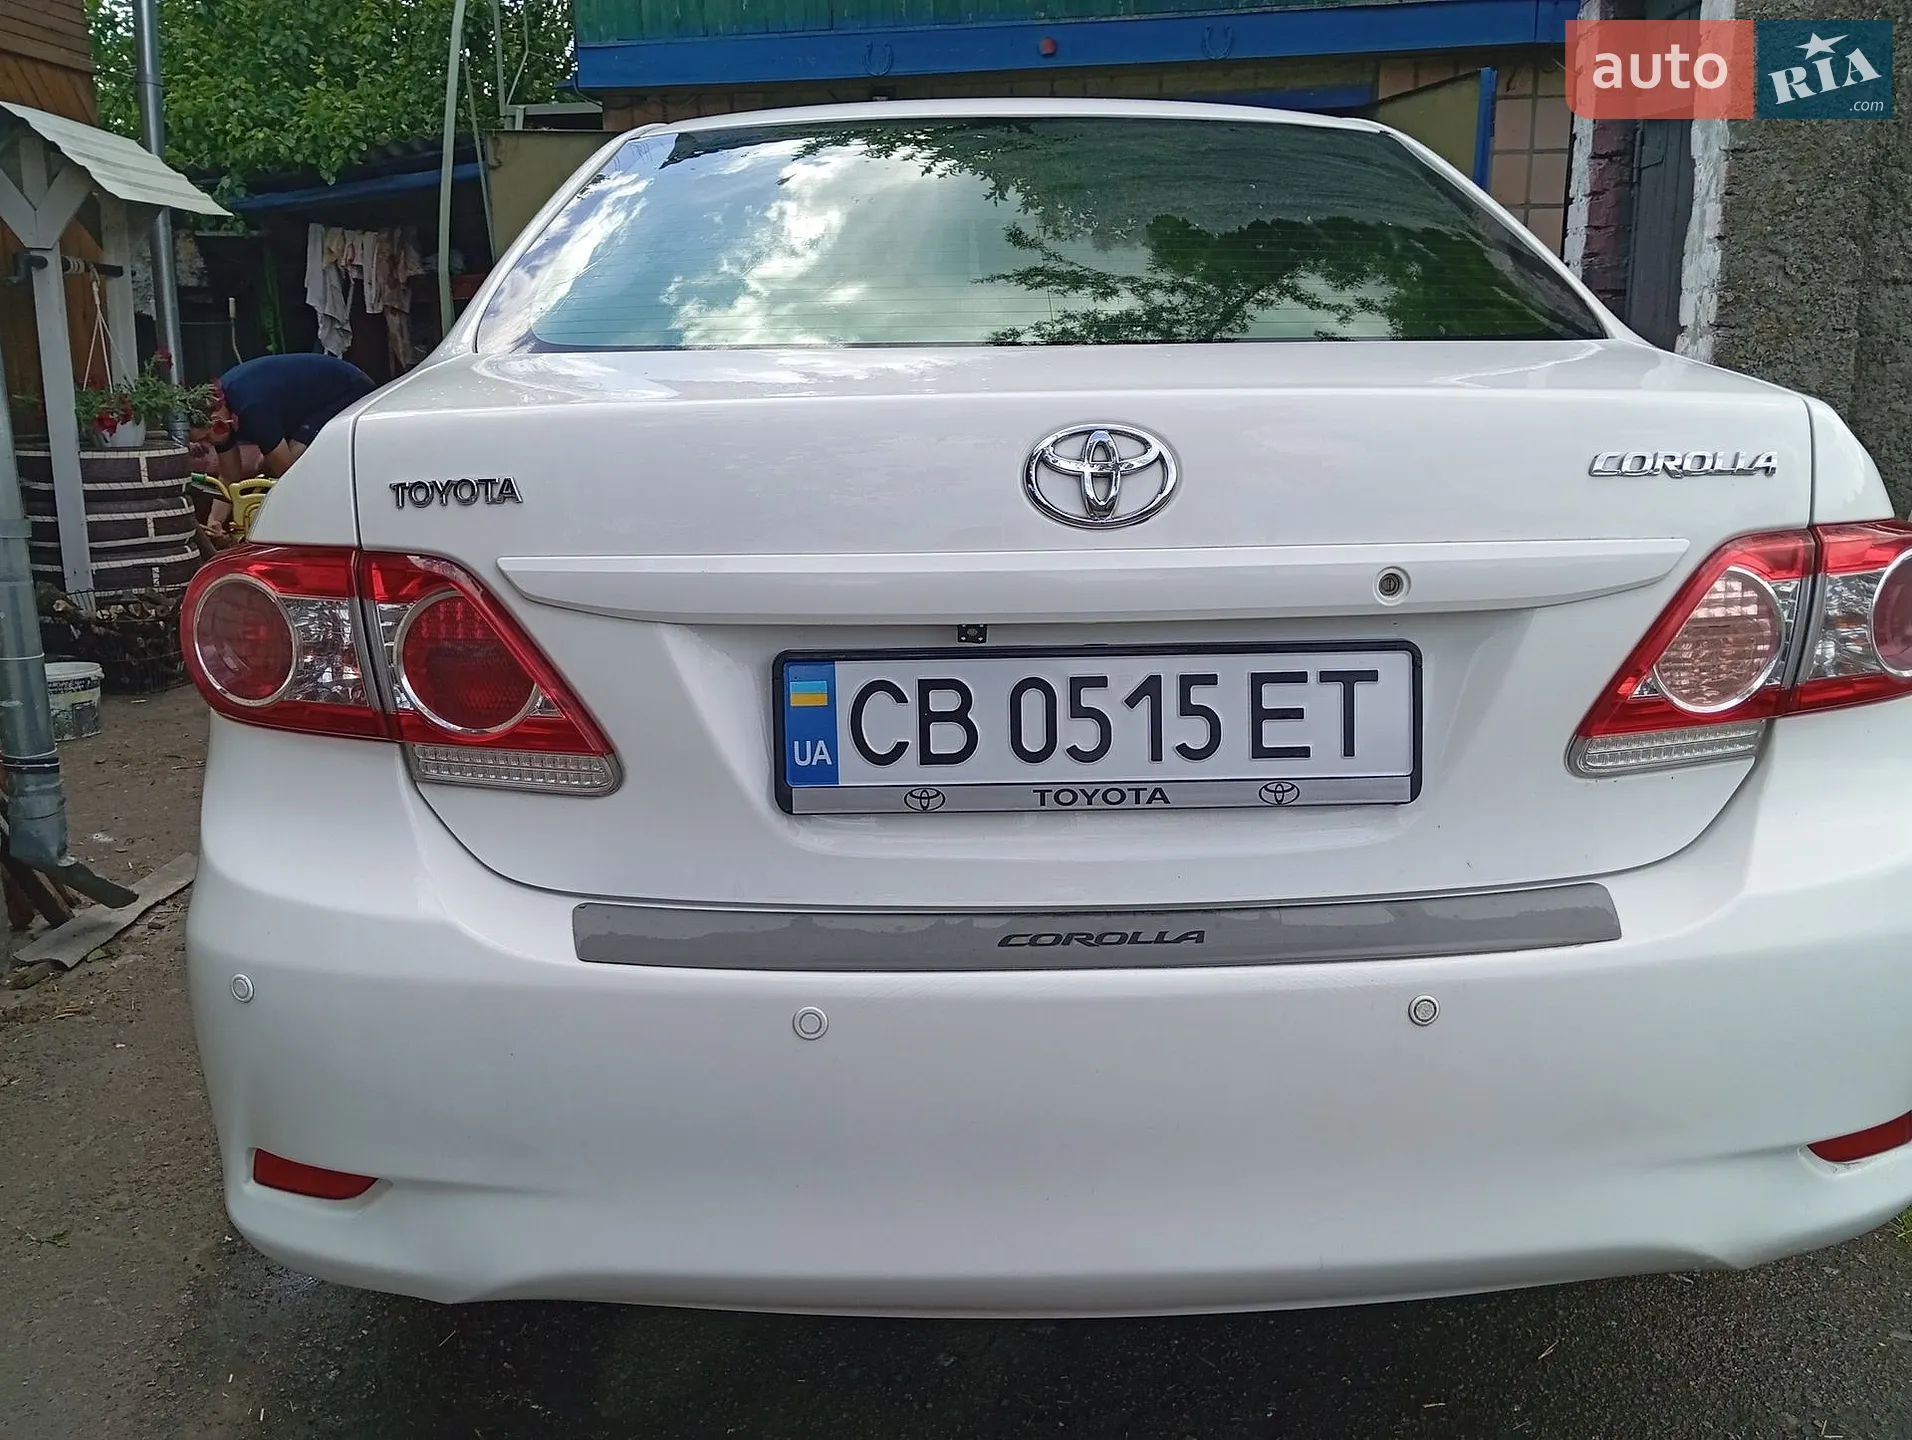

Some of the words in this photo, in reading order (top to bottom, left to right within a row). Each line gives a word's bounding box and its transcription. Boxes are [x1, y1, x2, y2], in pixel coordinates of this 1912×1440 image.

[1588, 450, 1777, 478] COROLLA
[389, 476, 524, 508] TOYOTA
[849, 677, 979, 767] CB
[1008, 672, 1223, 765] 0515
[1250, 668, 1379, 759] ET
[793, 740, 832, 766] UA
[1033, 786, 1171, 807] TOYOTA
[996, 930, 1206, 948] COROLLA
